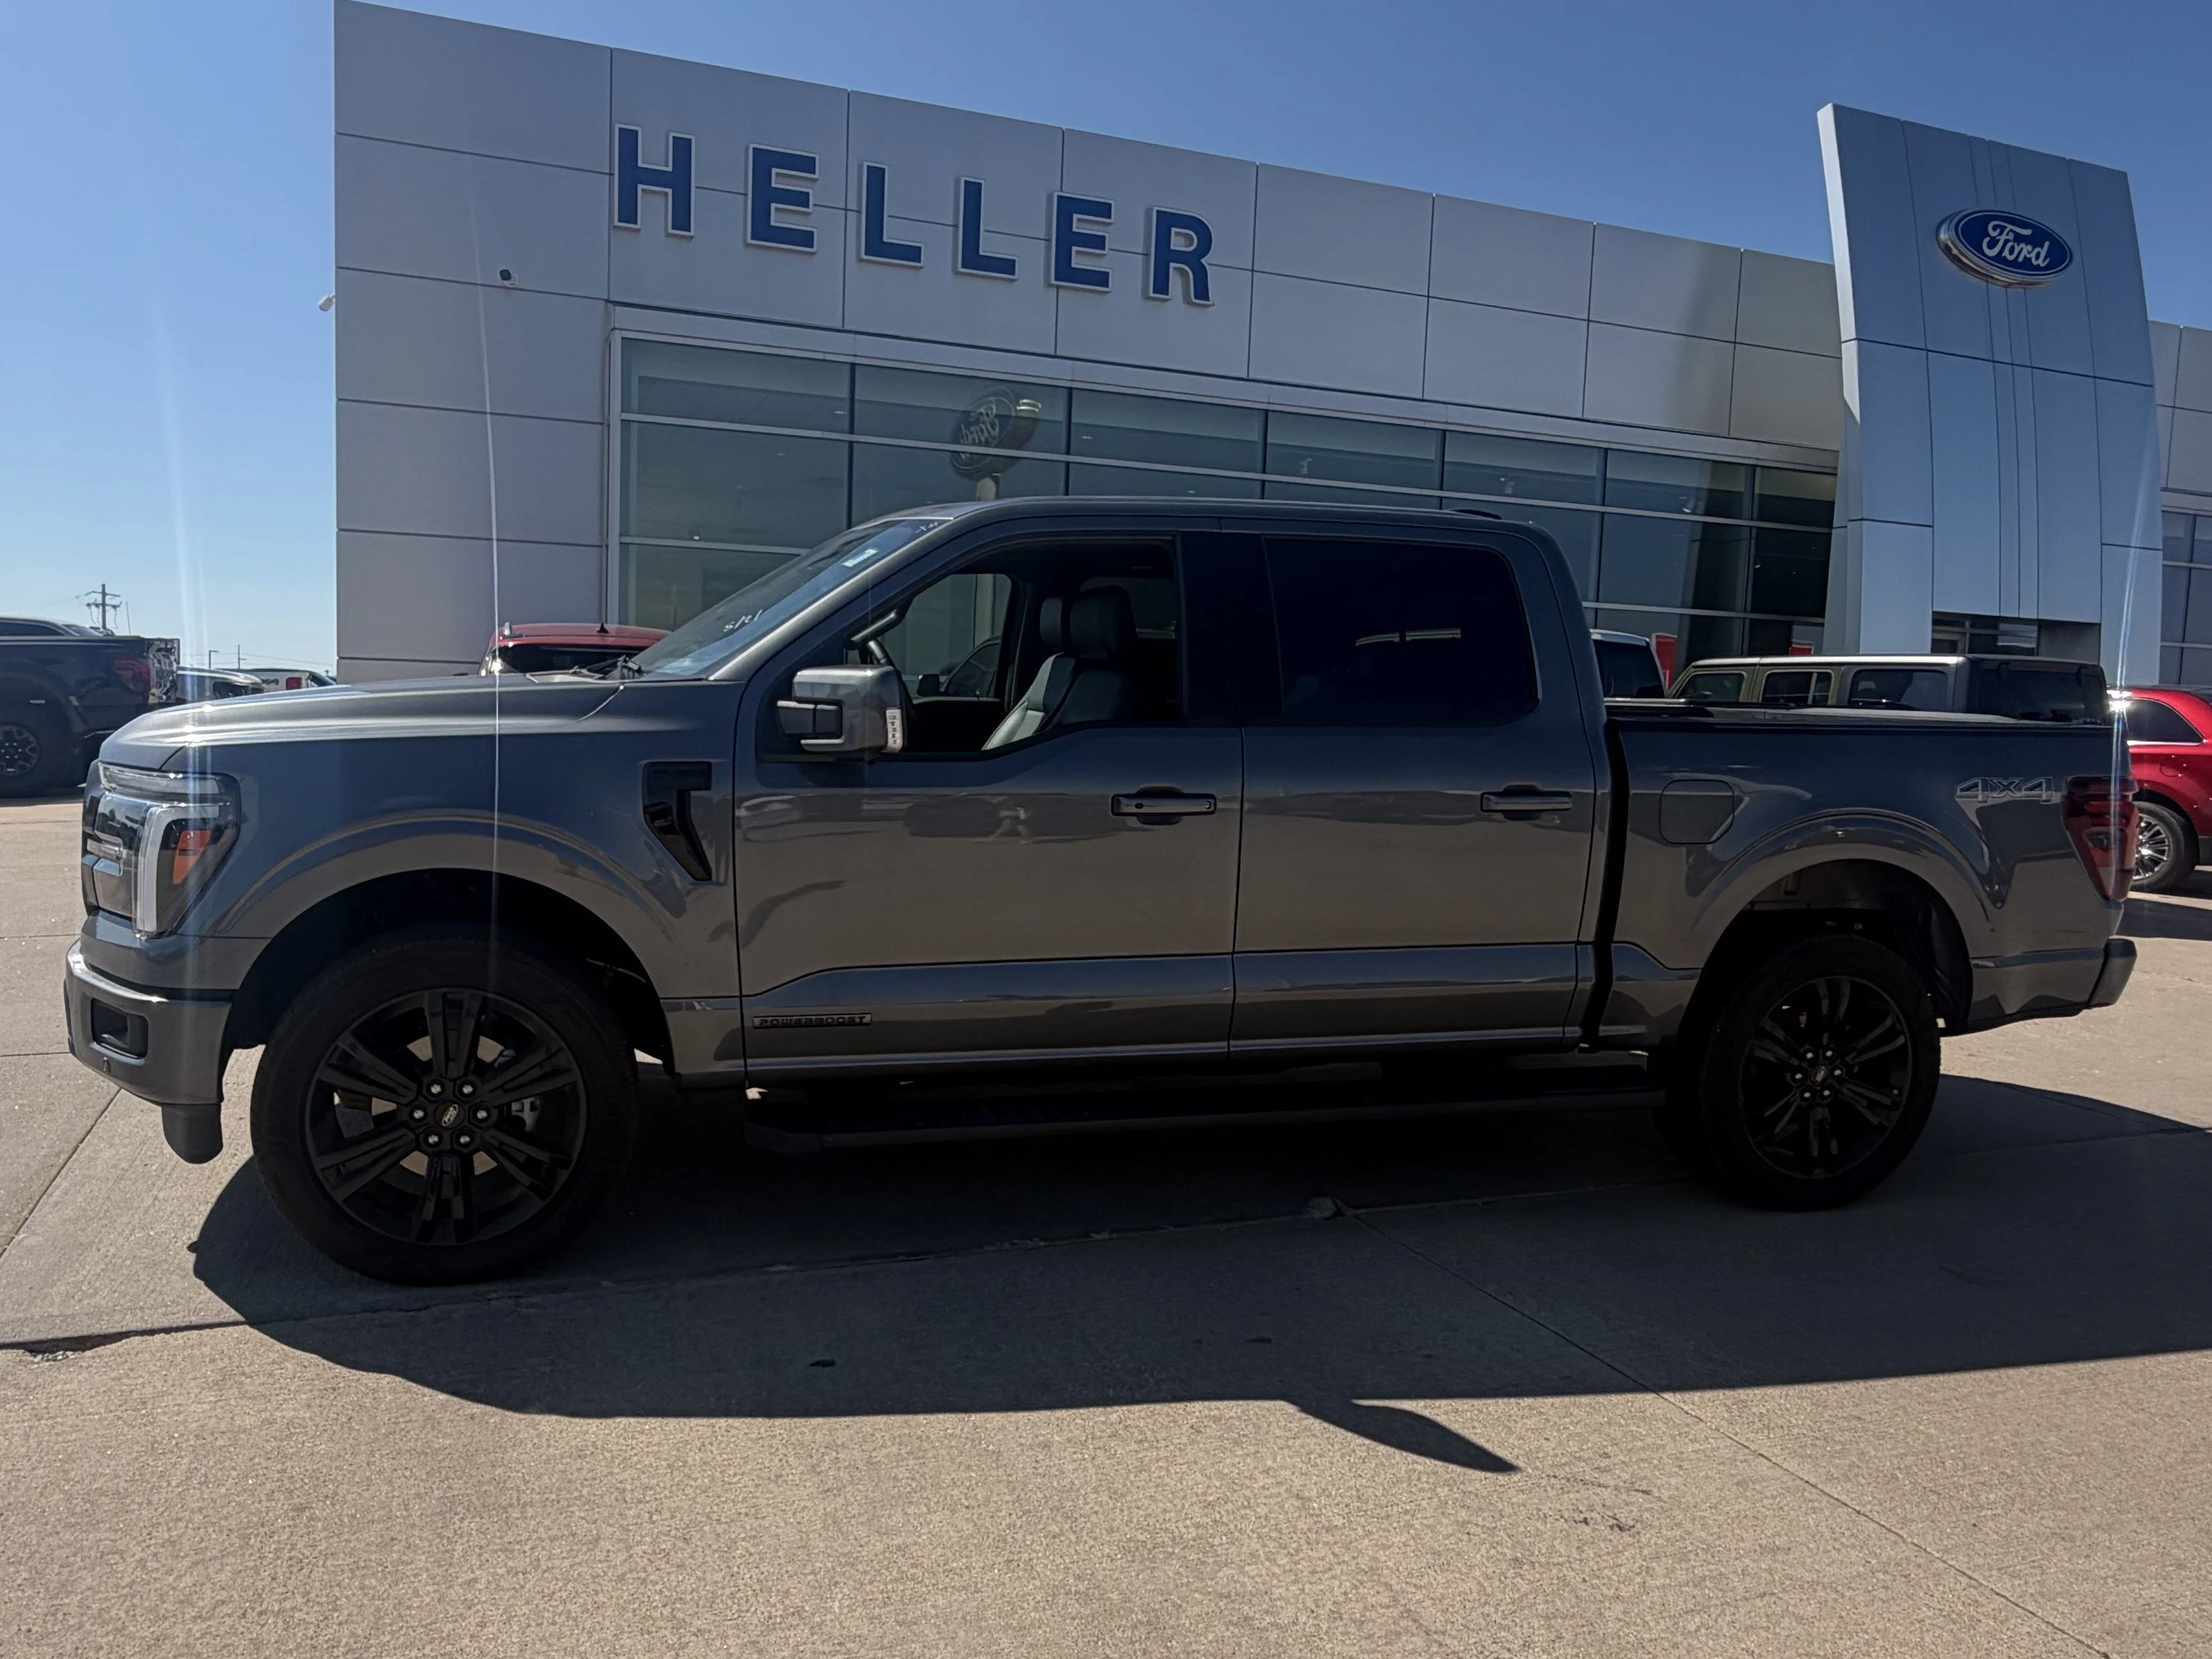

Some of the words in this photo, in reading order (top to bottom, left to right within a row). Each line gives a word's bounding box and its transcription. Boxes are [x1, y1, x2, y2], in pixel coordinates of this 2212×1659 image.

[613, 124, 1214, 307] HELLER
[1982, 221, 2051, 267] Ford
[759, 1015, 866, 1026] POWERBOOST
